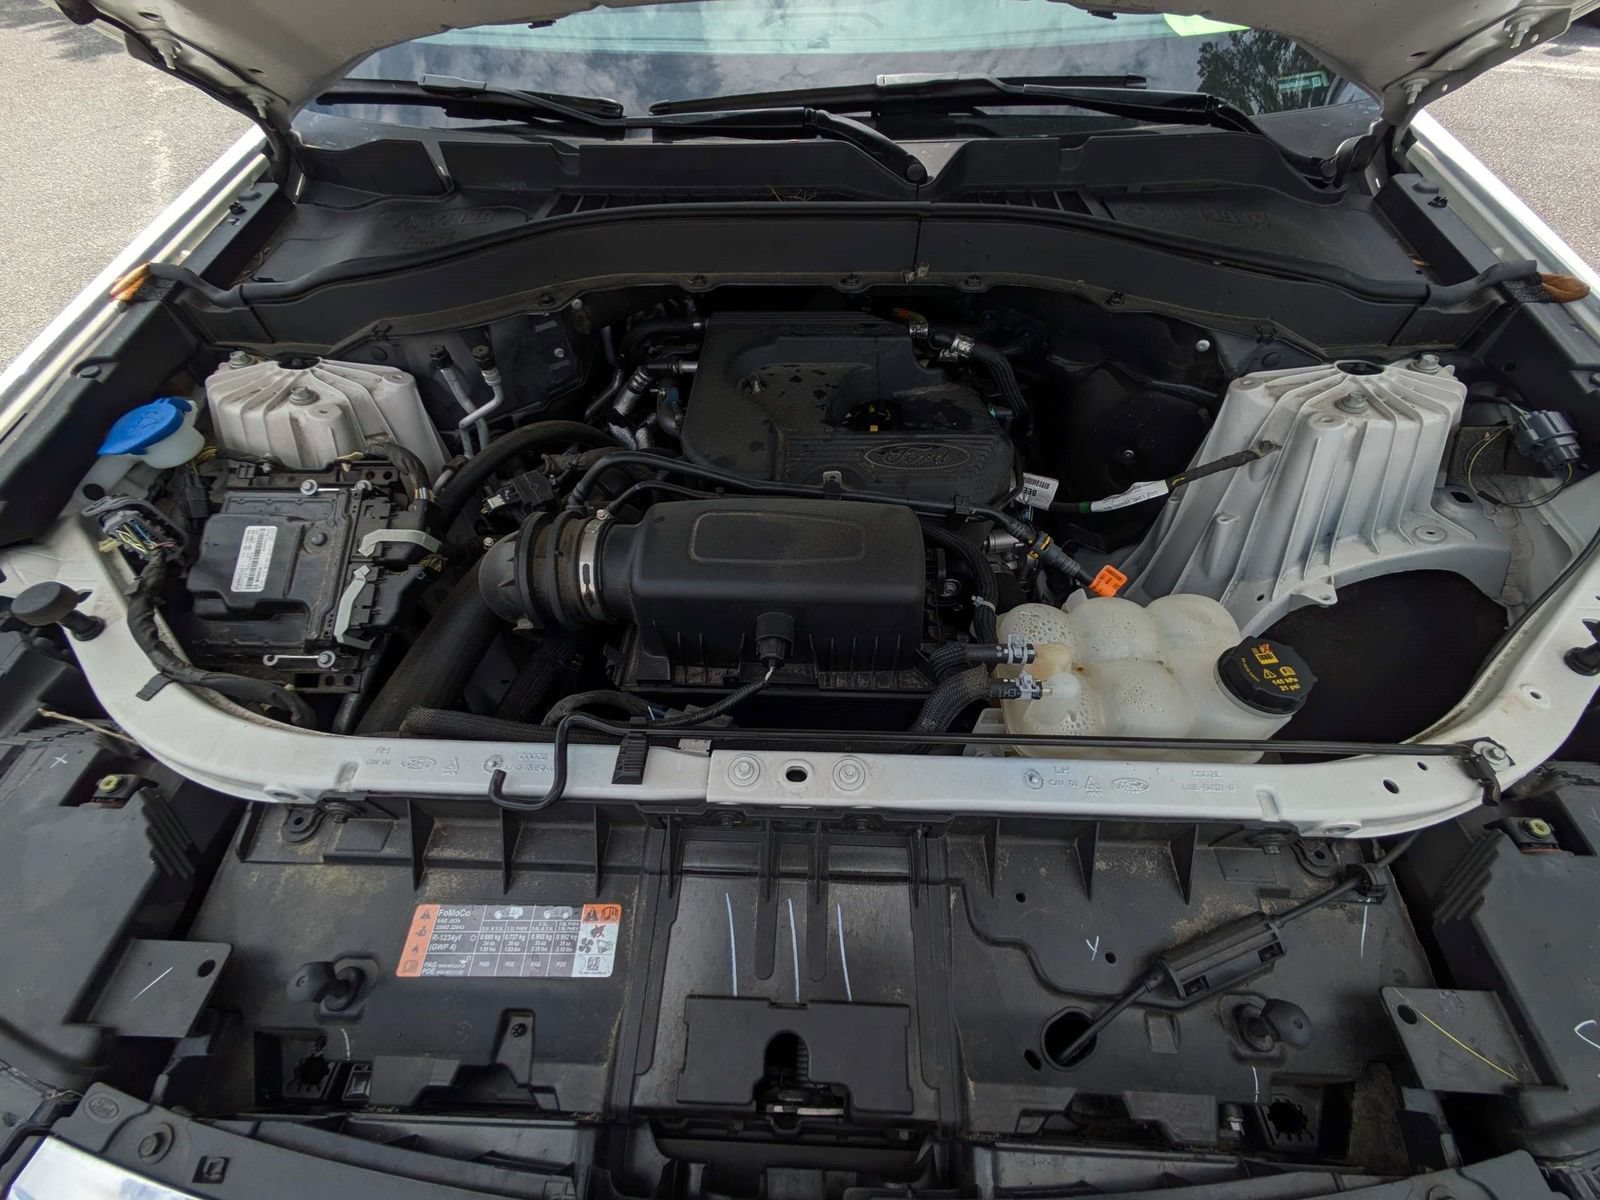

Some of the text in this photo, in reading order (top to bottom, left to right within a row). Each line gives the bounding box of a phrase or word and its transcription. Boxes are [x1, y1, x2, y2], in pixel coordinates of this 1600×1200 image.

[439, 908, 471, 917] FoMoCo
[432, 934, 463, 943] R-1234yf
[429, 943, 450, 952] (GWP
